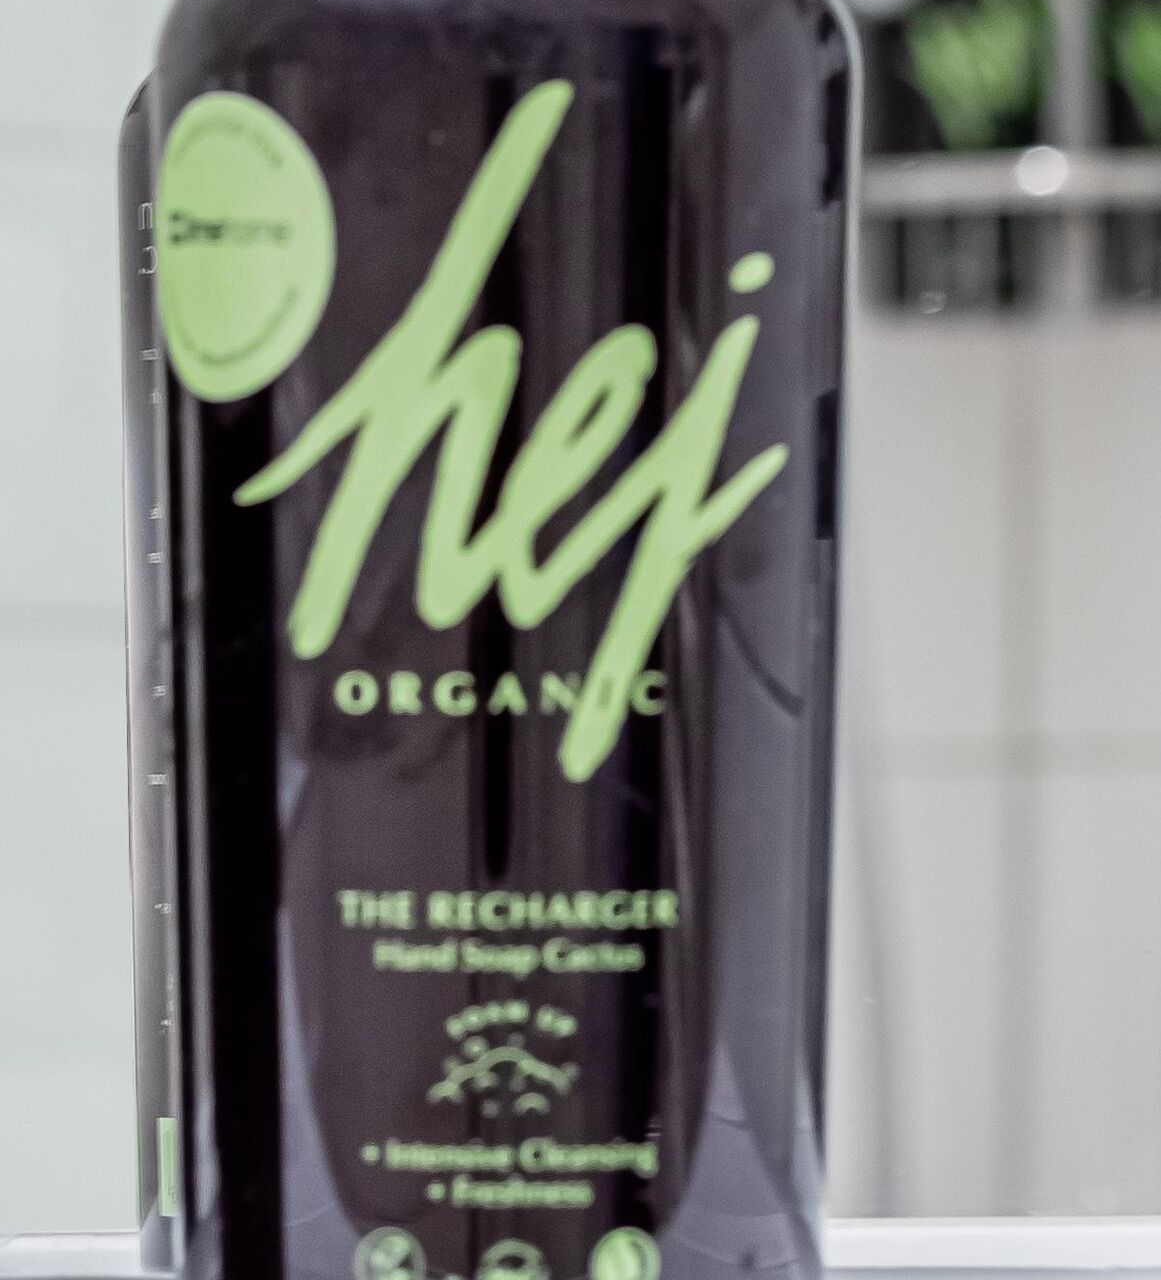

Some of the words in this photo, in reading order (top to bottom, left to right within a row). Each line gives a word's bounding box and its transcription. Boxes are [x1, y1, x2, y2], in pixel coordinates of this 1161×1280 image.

[233, 78, 790, 782] hej
[334, 669, 668, 717] ORGANIC
[338, 889, 416, 929] THE
[428, 889, 678, 930] RECHARGER
[373, 937, 459, 972] Hand
[460, 937, 540, 981] Soap
[541, 936, 645, 973] Cactus
